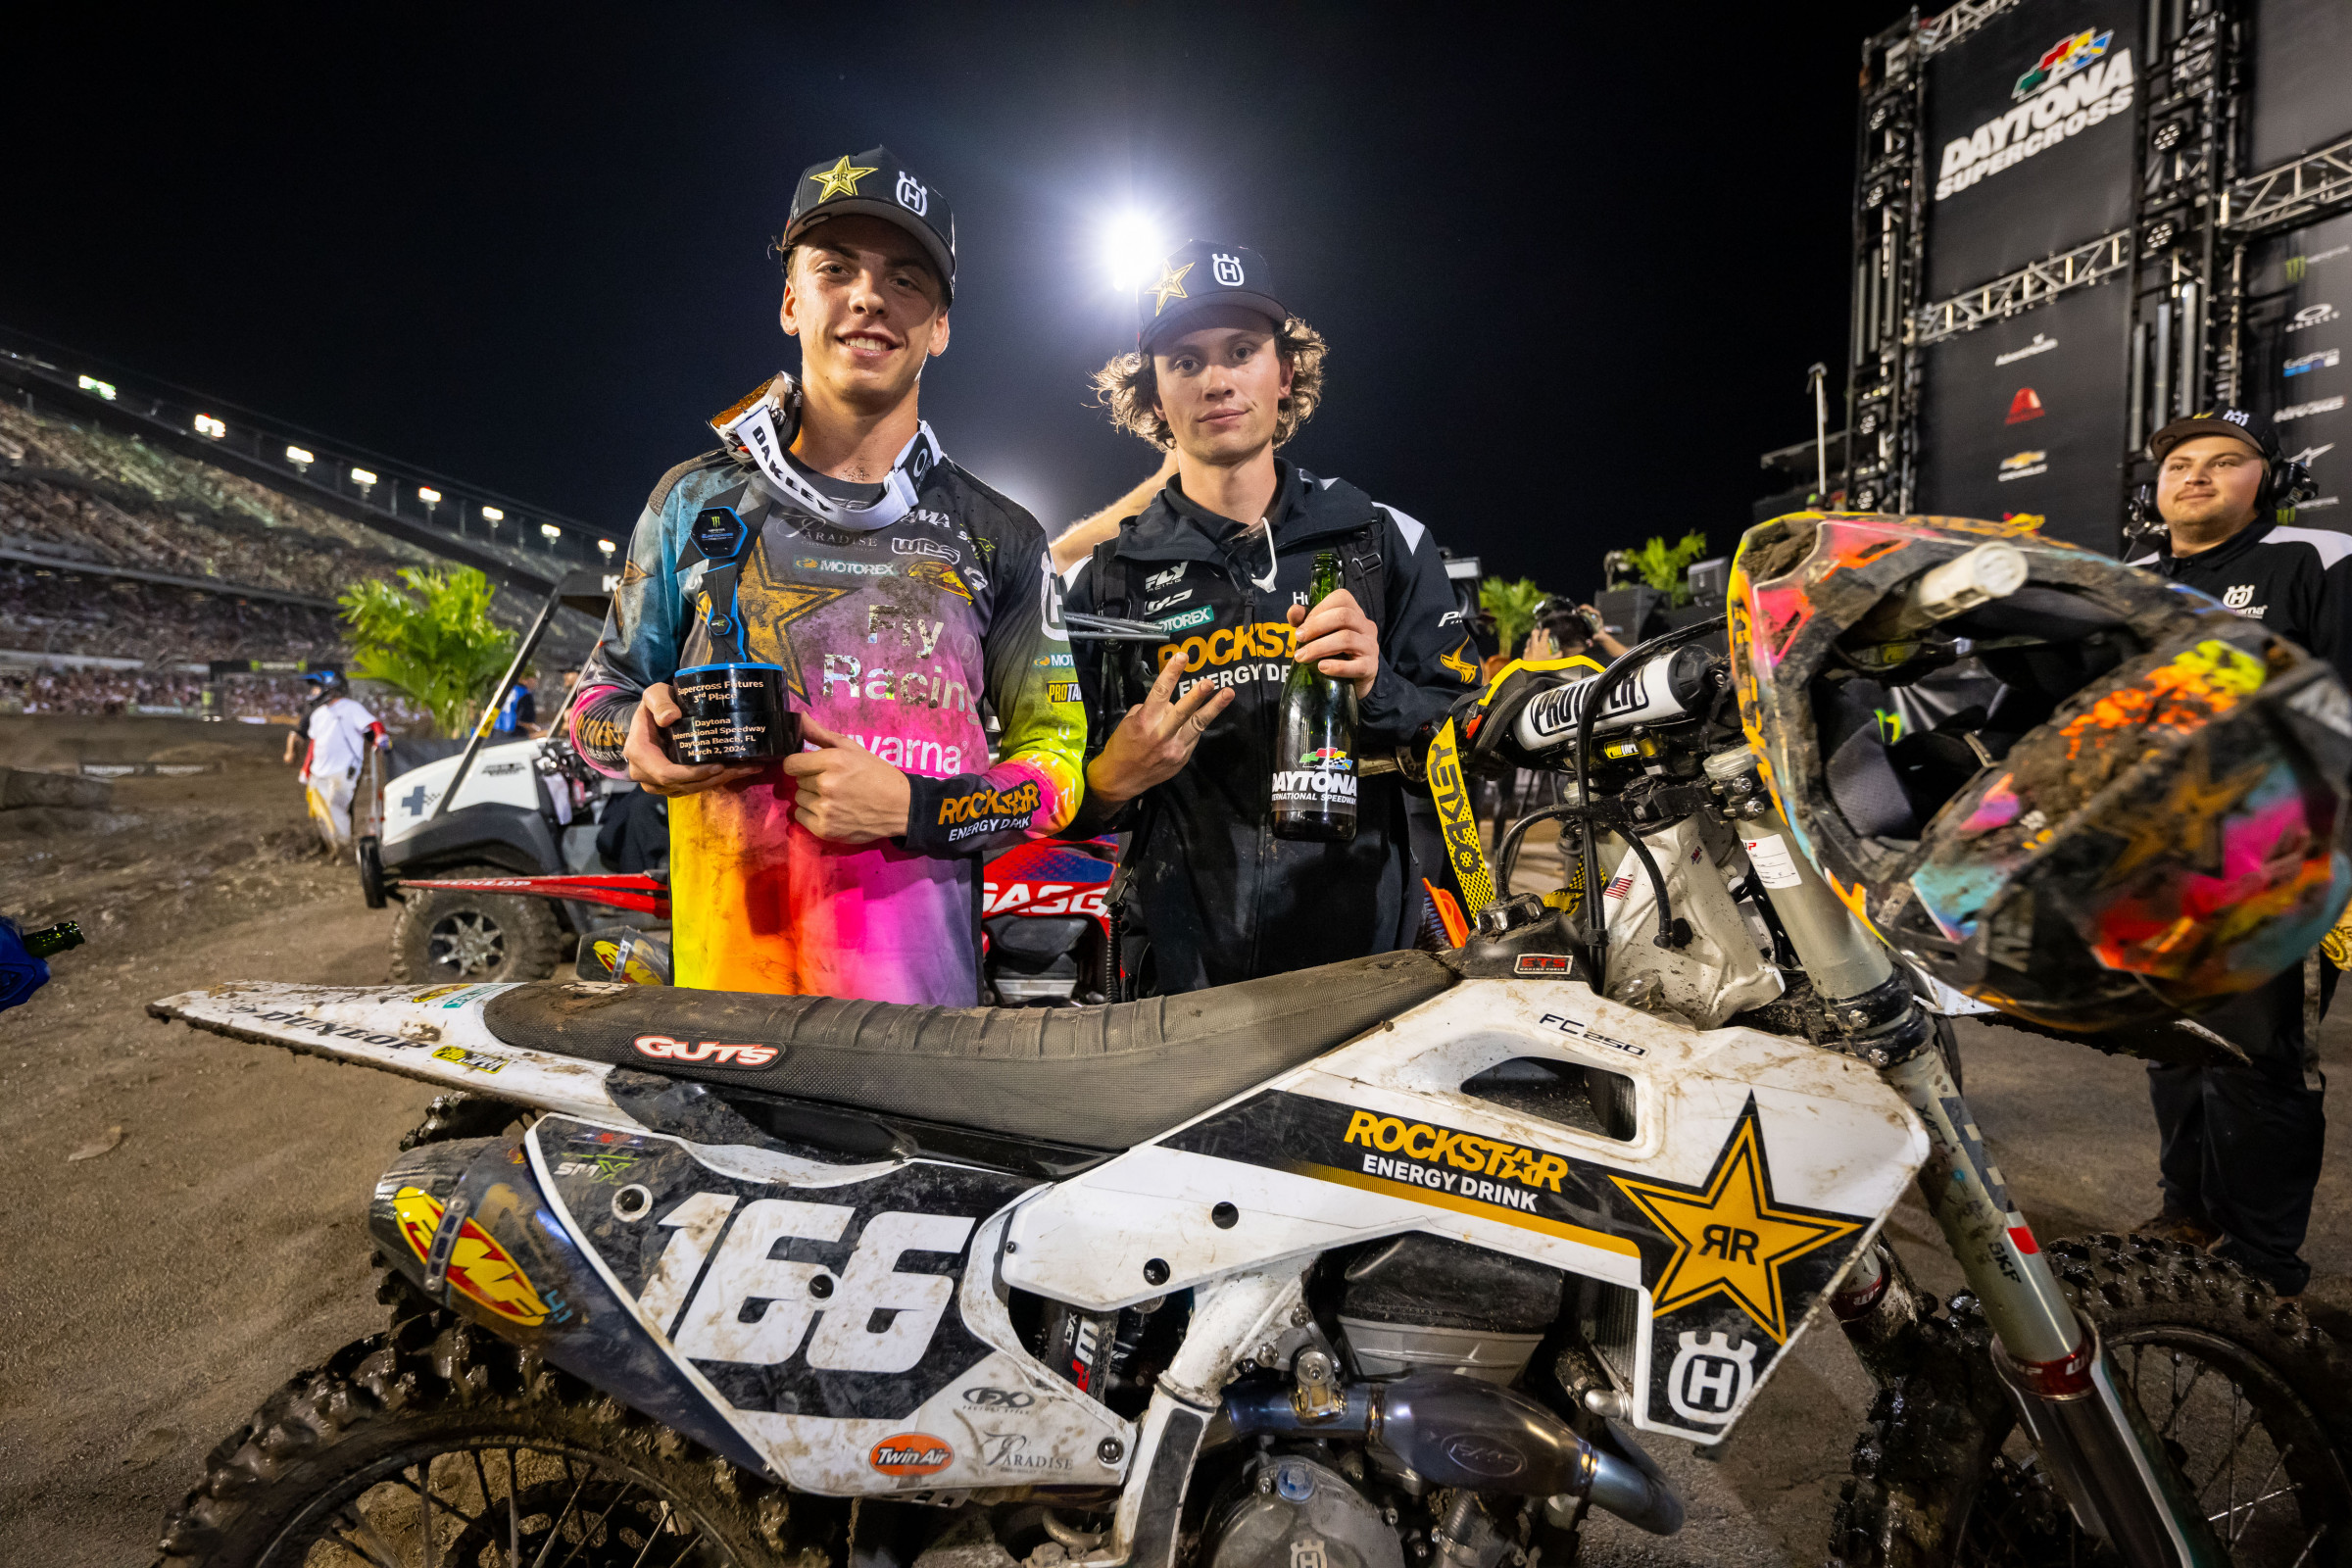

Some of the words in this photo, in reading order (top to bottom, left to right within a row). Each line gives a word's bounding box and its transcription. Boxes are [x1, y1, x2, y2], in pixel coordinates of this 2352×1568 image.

[1939, 48, 2134, 180] DAYTONA
[1935, 85, 2134, 201] SUPERCROSS
[753, 425, 834, 512] OAKLEY
[819, 560, 894, 575] MOTOREX
[867, 604, 945, 660] Fly
[677, 681, 722, 696] Supercross
[724, 680, 764, 689] Futures
[694, 692, 707, 704] 3rd
[709, 692, 738, 702] Place
[822, 653, 981, 725] Racing
[695, 716, 731, 727] Daytona
[719, 725, 766, 735] Speedway
[679, 738, 710, 749] Daytona
[712, 736, 744, 745] Beach,
[688, 748, 711, 758] March
[724, 745, 747, 754] 2024
[847, 734, 962, 775] varna
[1272, 770, 1357, 797] DAYTONA
[1320, 794, 1357, 806] SPEEDWAY
[1430, 743, 1480, 875] OAKLEY
[948, 817, 1000, 842] ENERGY
[983, 881, 1112, 919] GASG
[1521, 957, 1567, 968] ETS
[255, 1010, 429, 1050] DUNLOP
[1539, 1013, 1585, 1035] FC
[1582, 1031, 1646, 1056] 250
[634, 1035, 779, 1066] GUTS
[1344, 1109, 1569, 1193] ROCKSTAR
[1362, 1153, 1458, 1191] ENERGY
[1459, 1177, 1539, 1213] DRINK
[637, 1191, 977, 1374] 166
[876, 1446, 919, 1466] Twin
[919, 1446, 952, 1466] Air
